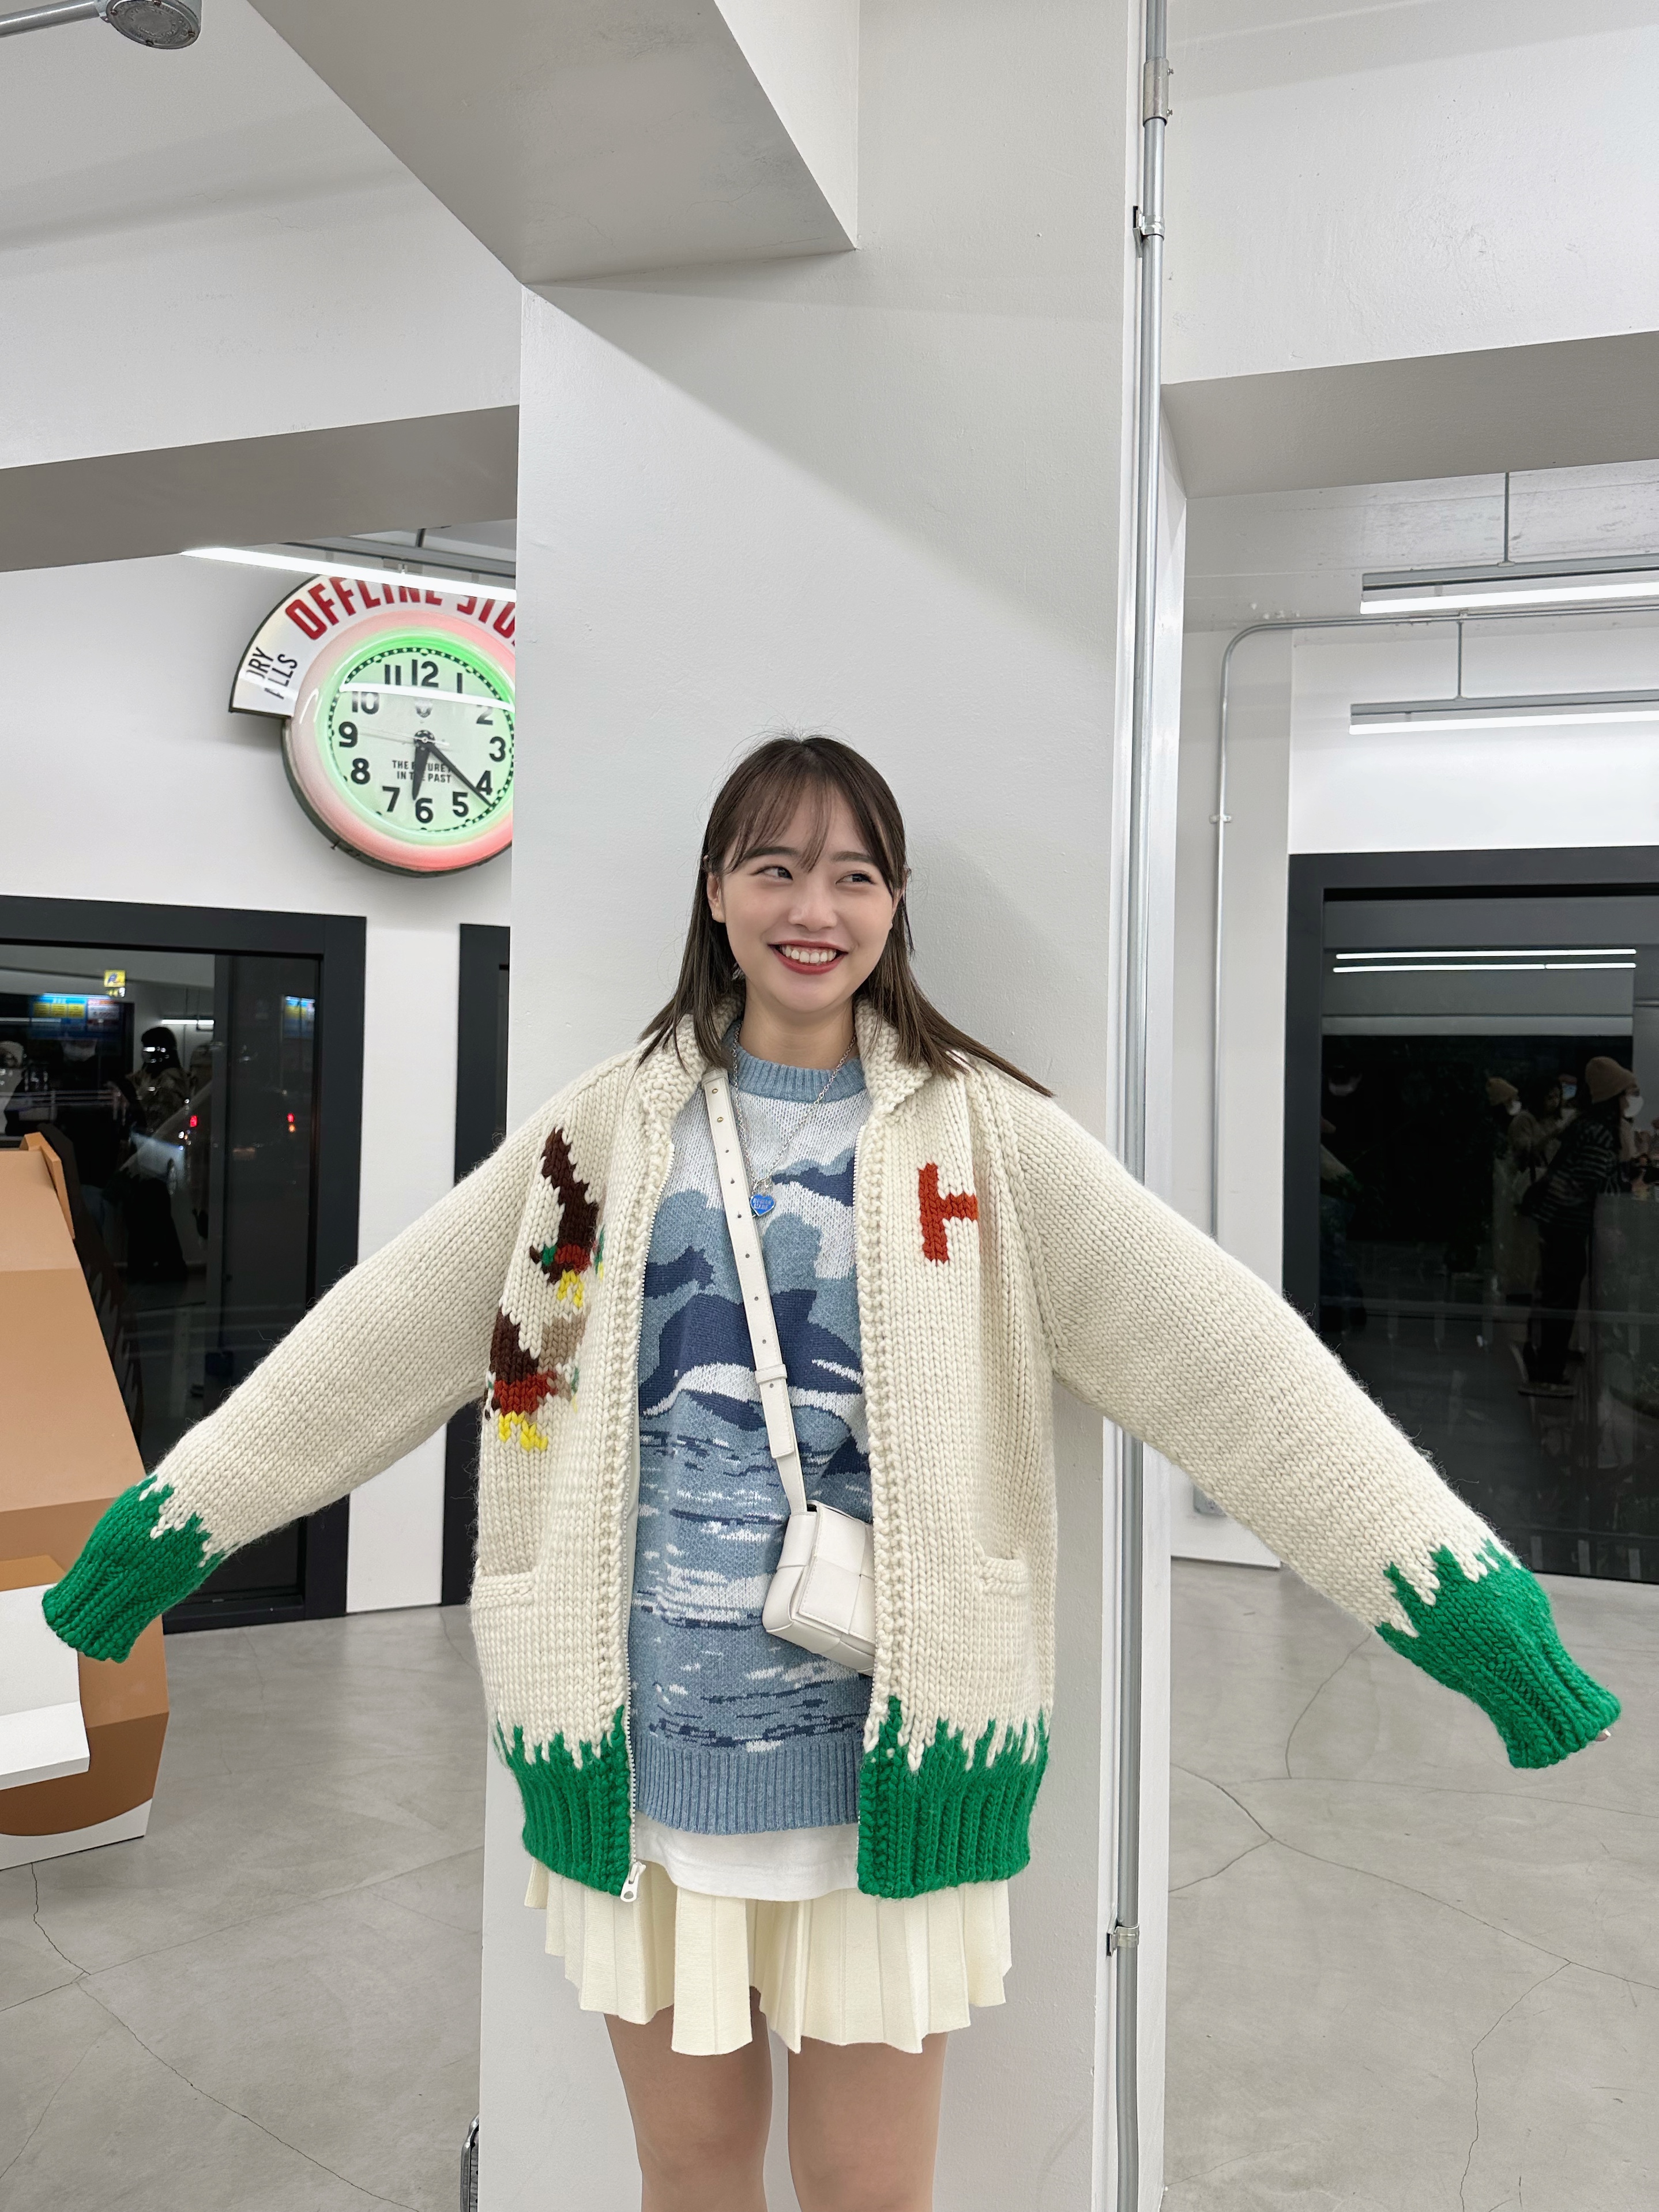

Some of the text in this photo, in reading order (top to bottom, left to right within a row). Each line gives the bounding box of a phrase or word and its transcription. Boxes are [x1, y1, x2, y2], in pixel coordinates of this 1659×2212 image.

[384, 664, 401, 685] 11
[412, 659, 439, 687] 12
[457, 673, 463, 693] 1
[352, 691, 379, 714] 10
[476, 705, 494, 725] 2
[338, 721, 358, 748] 9
[489, 736, 506, 762] 3
[351, 758, 370, 785] 8
[392, 760, 409, 770] THE
[411, 761, 445, 773] FURE
[397, 771, 407, 780] IN
[428, 773, 452, 783] PAST
[476, 770, 493, 796] 4
[382, 786, 400, 812] 7
[415, 798, 433, 824] 6
[452, 792, 469, 817] 5
